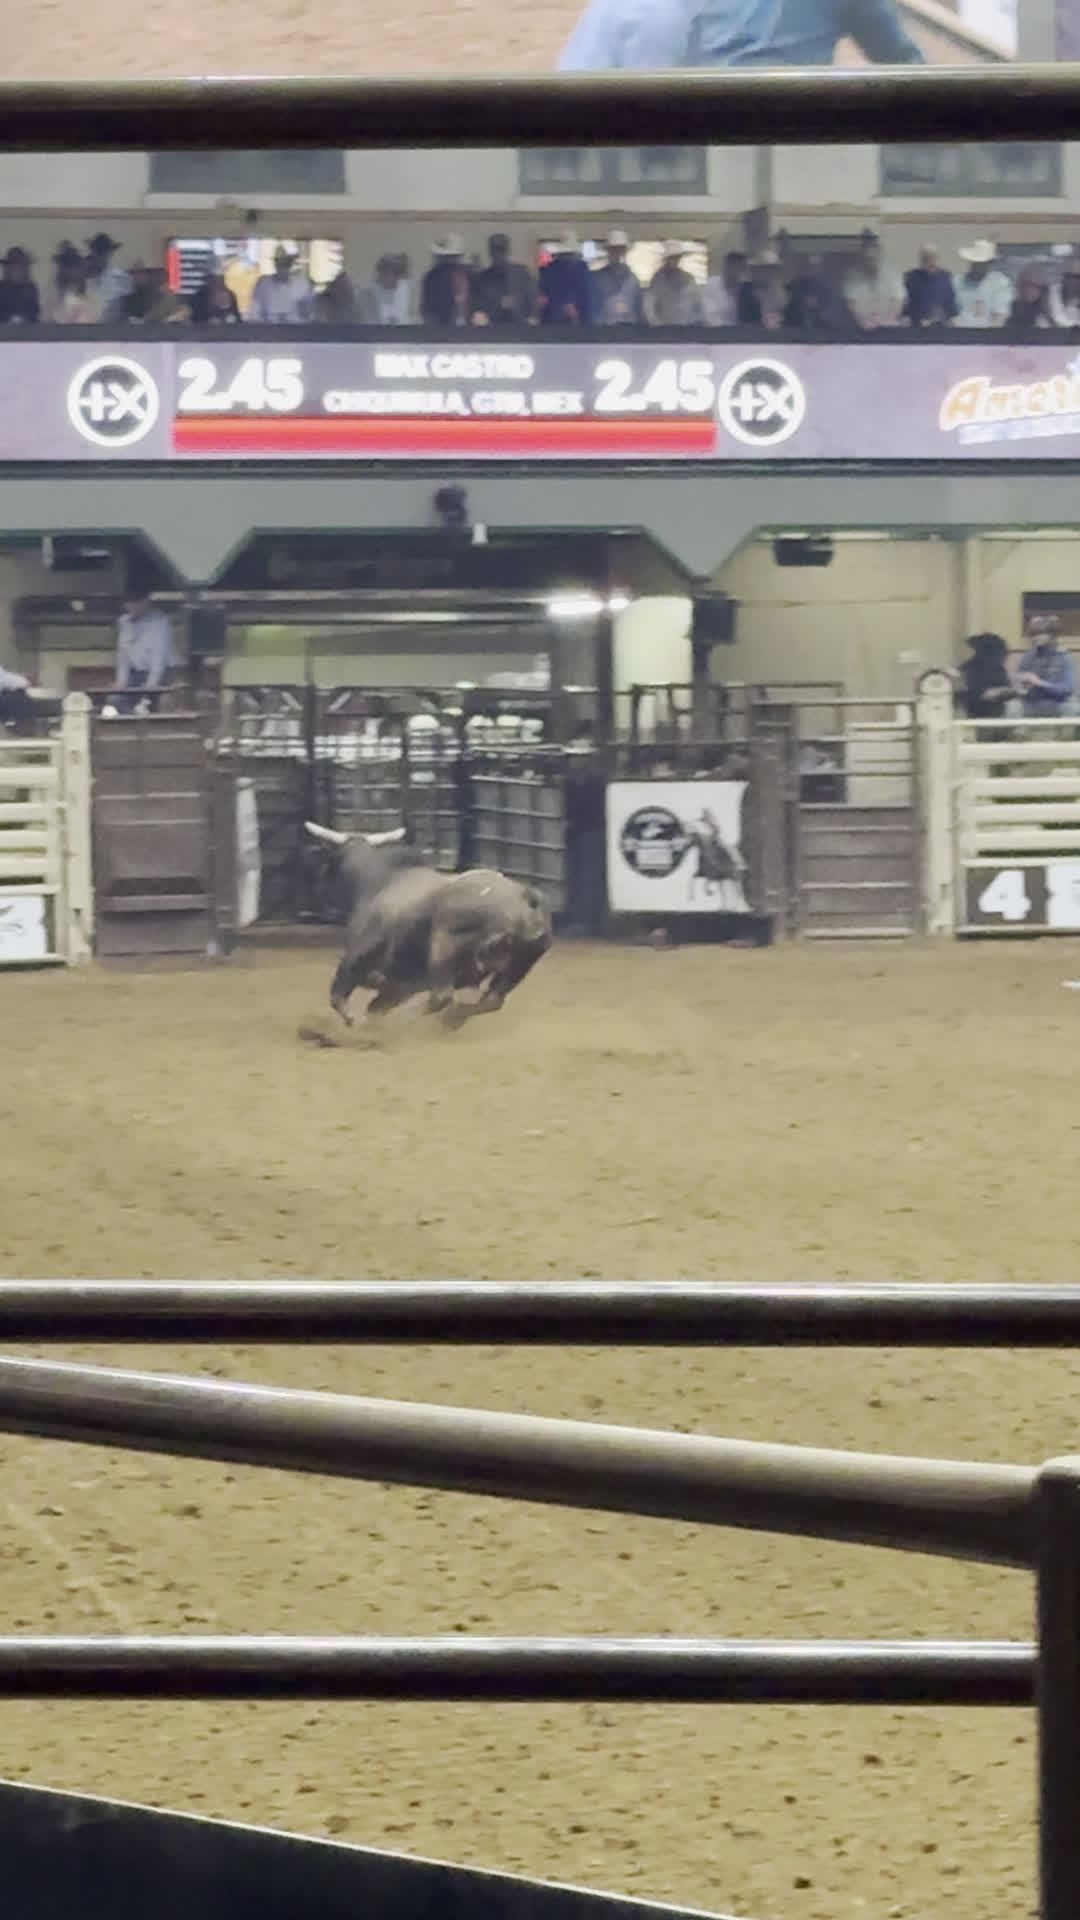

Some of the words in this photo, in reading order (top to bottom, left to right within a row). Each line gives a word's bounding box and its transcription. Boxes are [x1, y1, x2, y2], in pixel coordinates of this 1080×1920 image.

[177, 357, 304, 411] 2.45
[594, 359, 715, 412] 2.45
[978, 869, 1032, 920] 4
